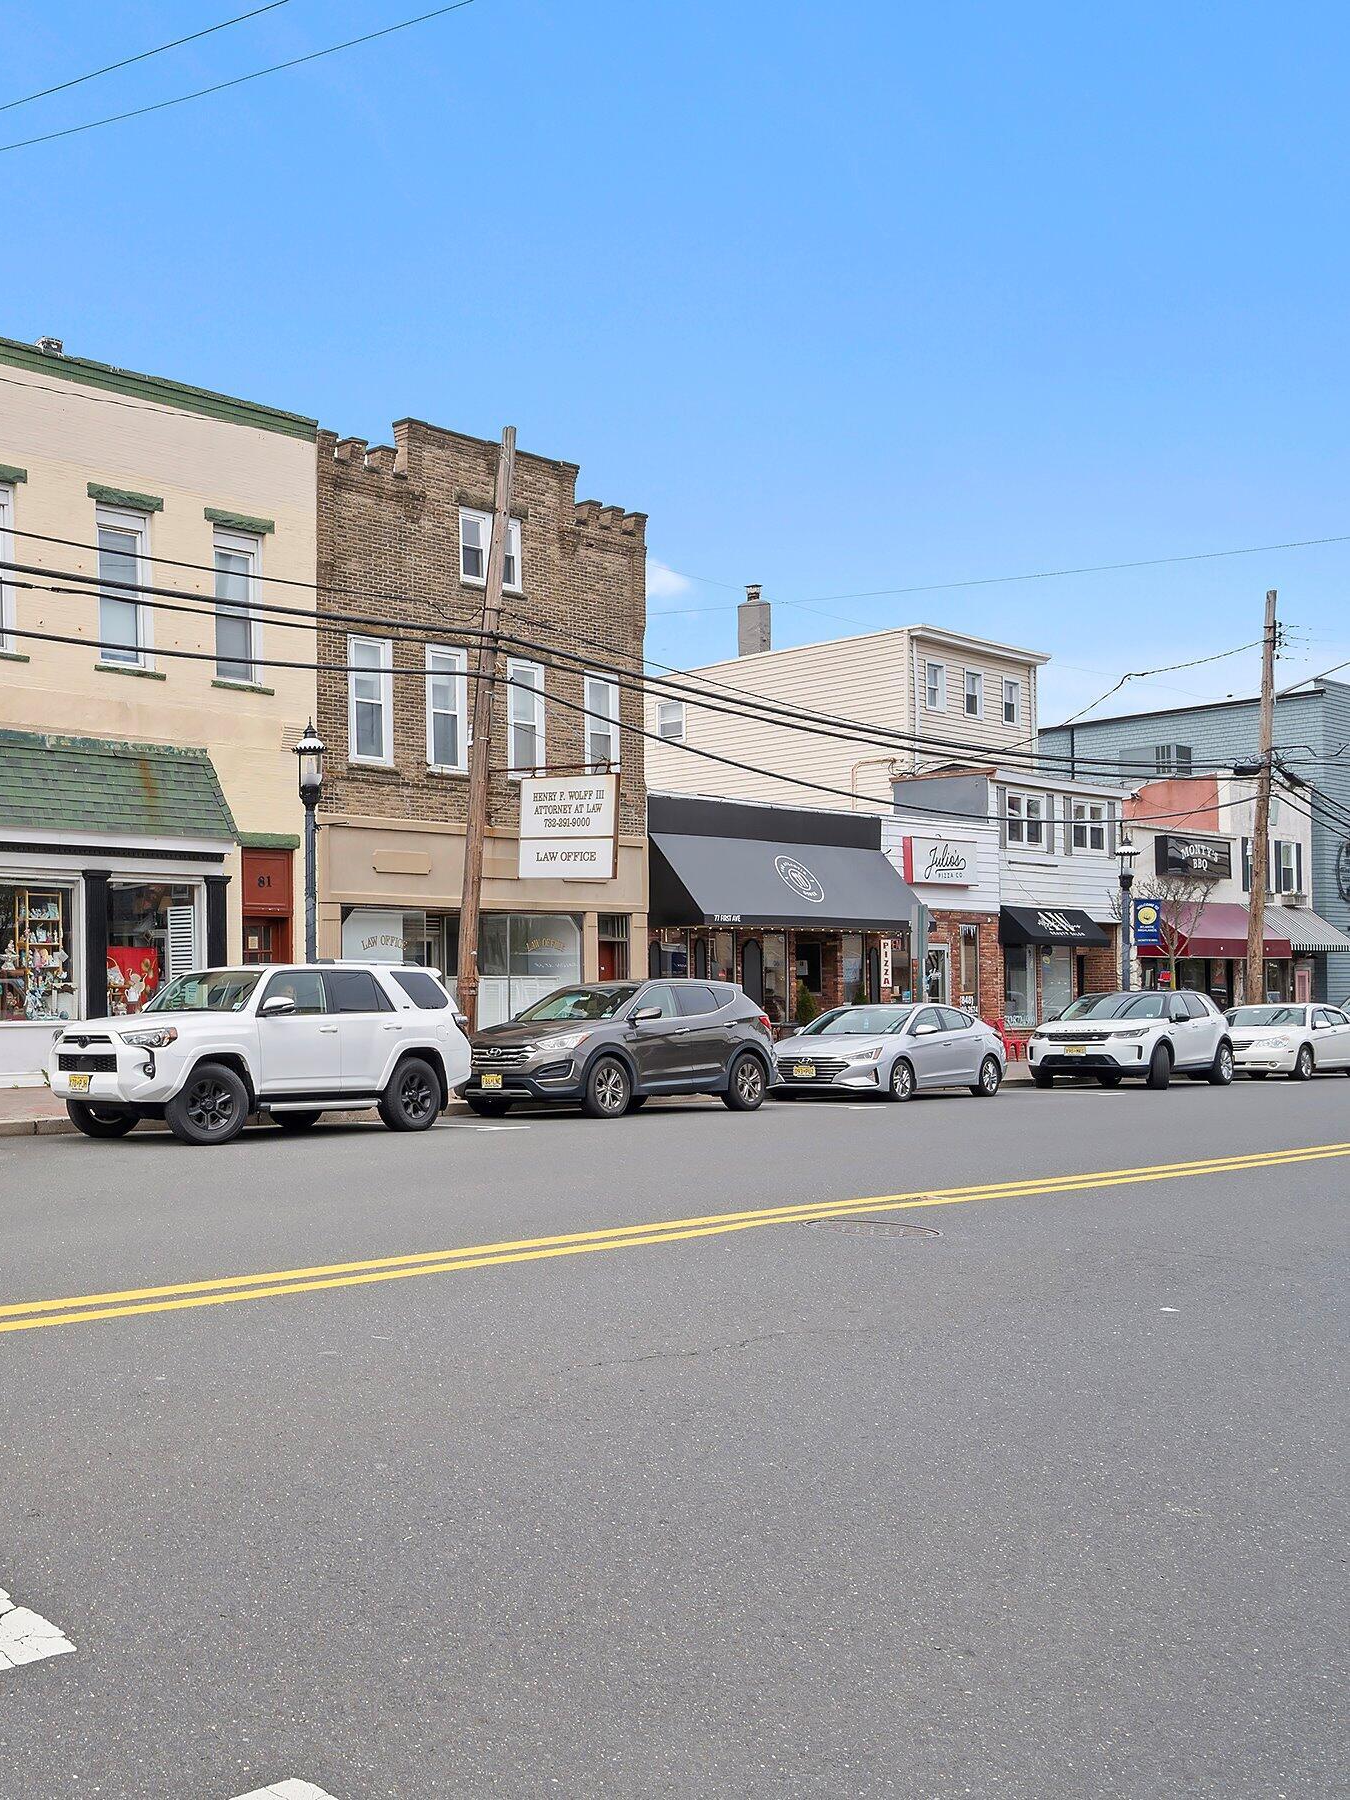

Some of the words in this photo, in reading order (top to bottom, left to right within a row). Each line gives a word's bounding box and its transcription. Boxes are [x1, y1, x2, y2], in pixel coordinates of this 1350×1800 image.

[532, 791, 558, 802] HENRY
[558, 791, 566, 801] F.
[568, 790, 594, 801] WOLFF
[595, 789, 605, 800] III
[533, 804, 573, 815] ATTORNEY
[573, 803, 585, 814] AT
[586, 803, 603, 813] LAW
[543, 817, 591, 828] 732-291-9000
[535, 852, 558, 862] LAW
[560, 851, 597, 862] OFFICE
[1180, 843, 1219, 863] MONTY'S
[924, 843, 967, 880] Julio's
[1192, 858, 1208, 871] BBQ
[257, 875, 273, 888] 81
[713, 914, 720, 922] 77
[720, 914, 732, 922] FIRST
[361, 935, 378, 951] LAW
[380, 934, 409, 951] OFFICE
[525, 938, 540, 952] LAW
